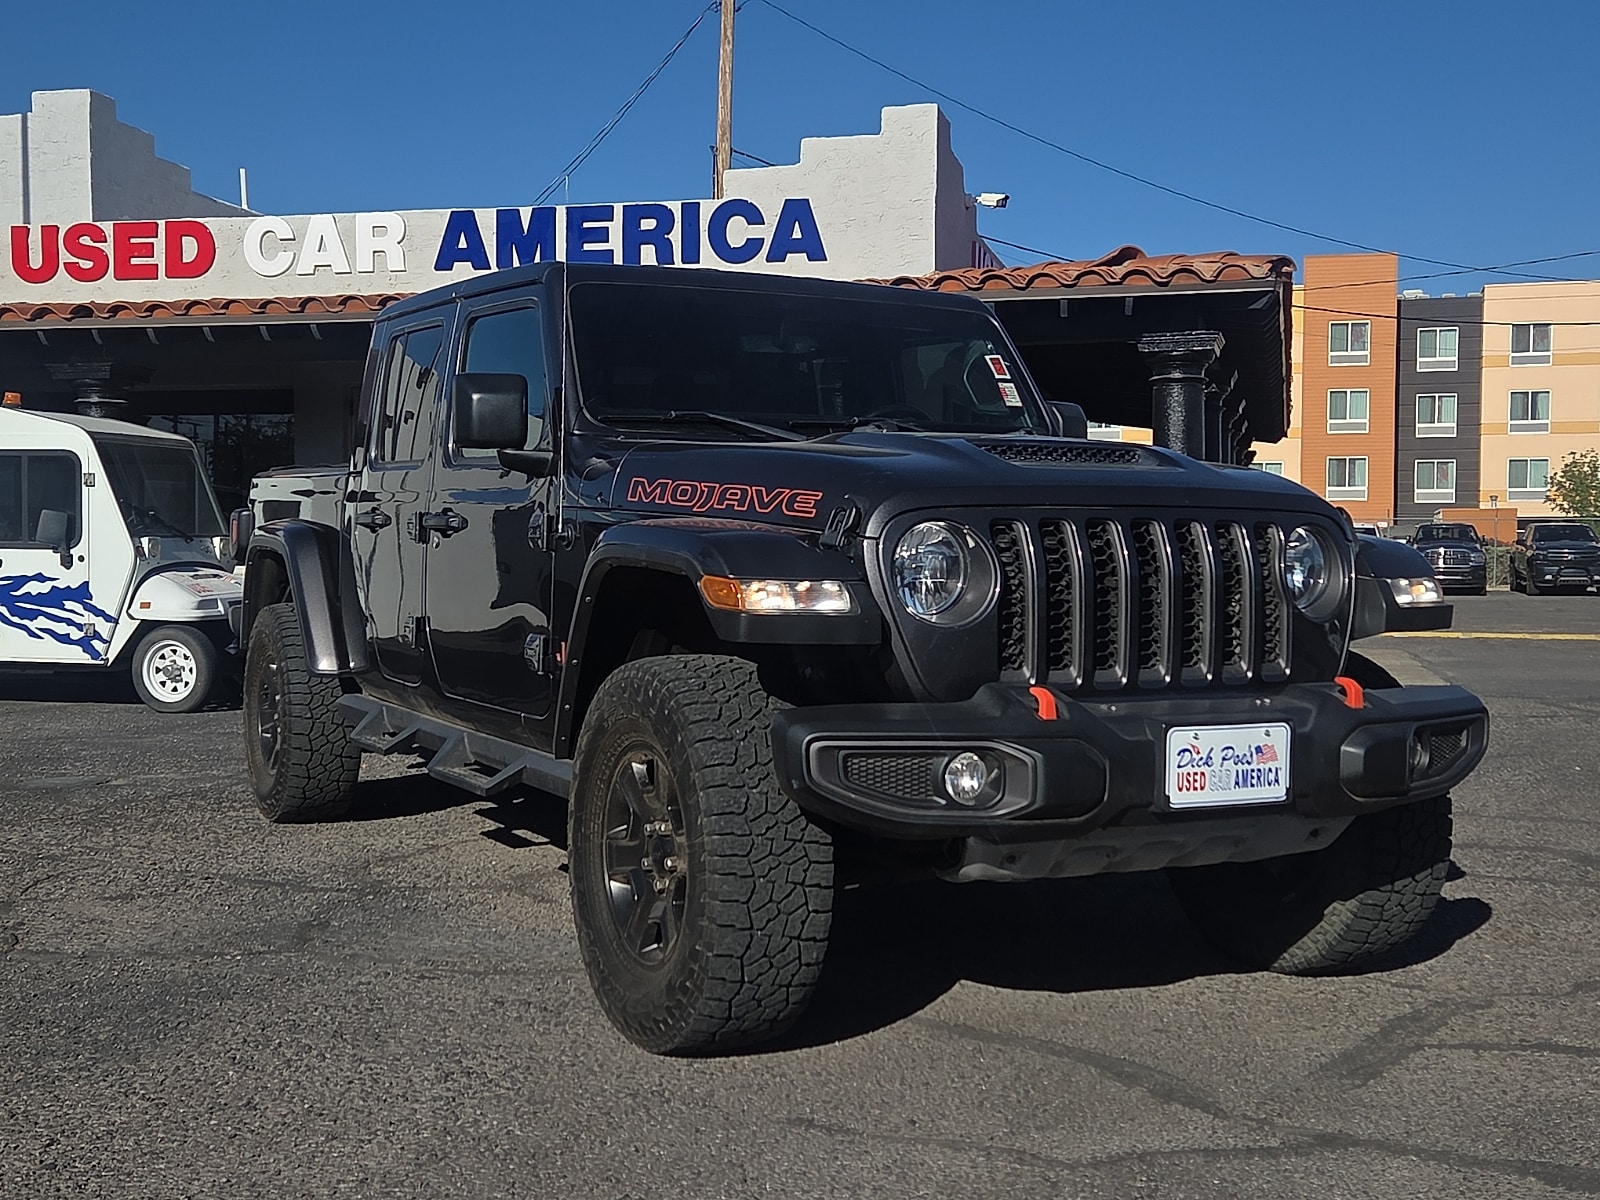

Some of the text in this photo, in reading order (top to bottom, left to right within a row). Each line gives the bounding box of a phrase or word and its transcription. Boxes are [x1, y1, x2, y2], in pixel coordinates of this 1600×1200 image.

[11, 197, 828, 284] USED CAR AMERICA
[627, 477, 823, 518] MOJAVE
[1176, 746, 1215, 769] Dick
[1176, 771, 1207, 793] USED
[1233, 766, 1281, 790] AMERICA
